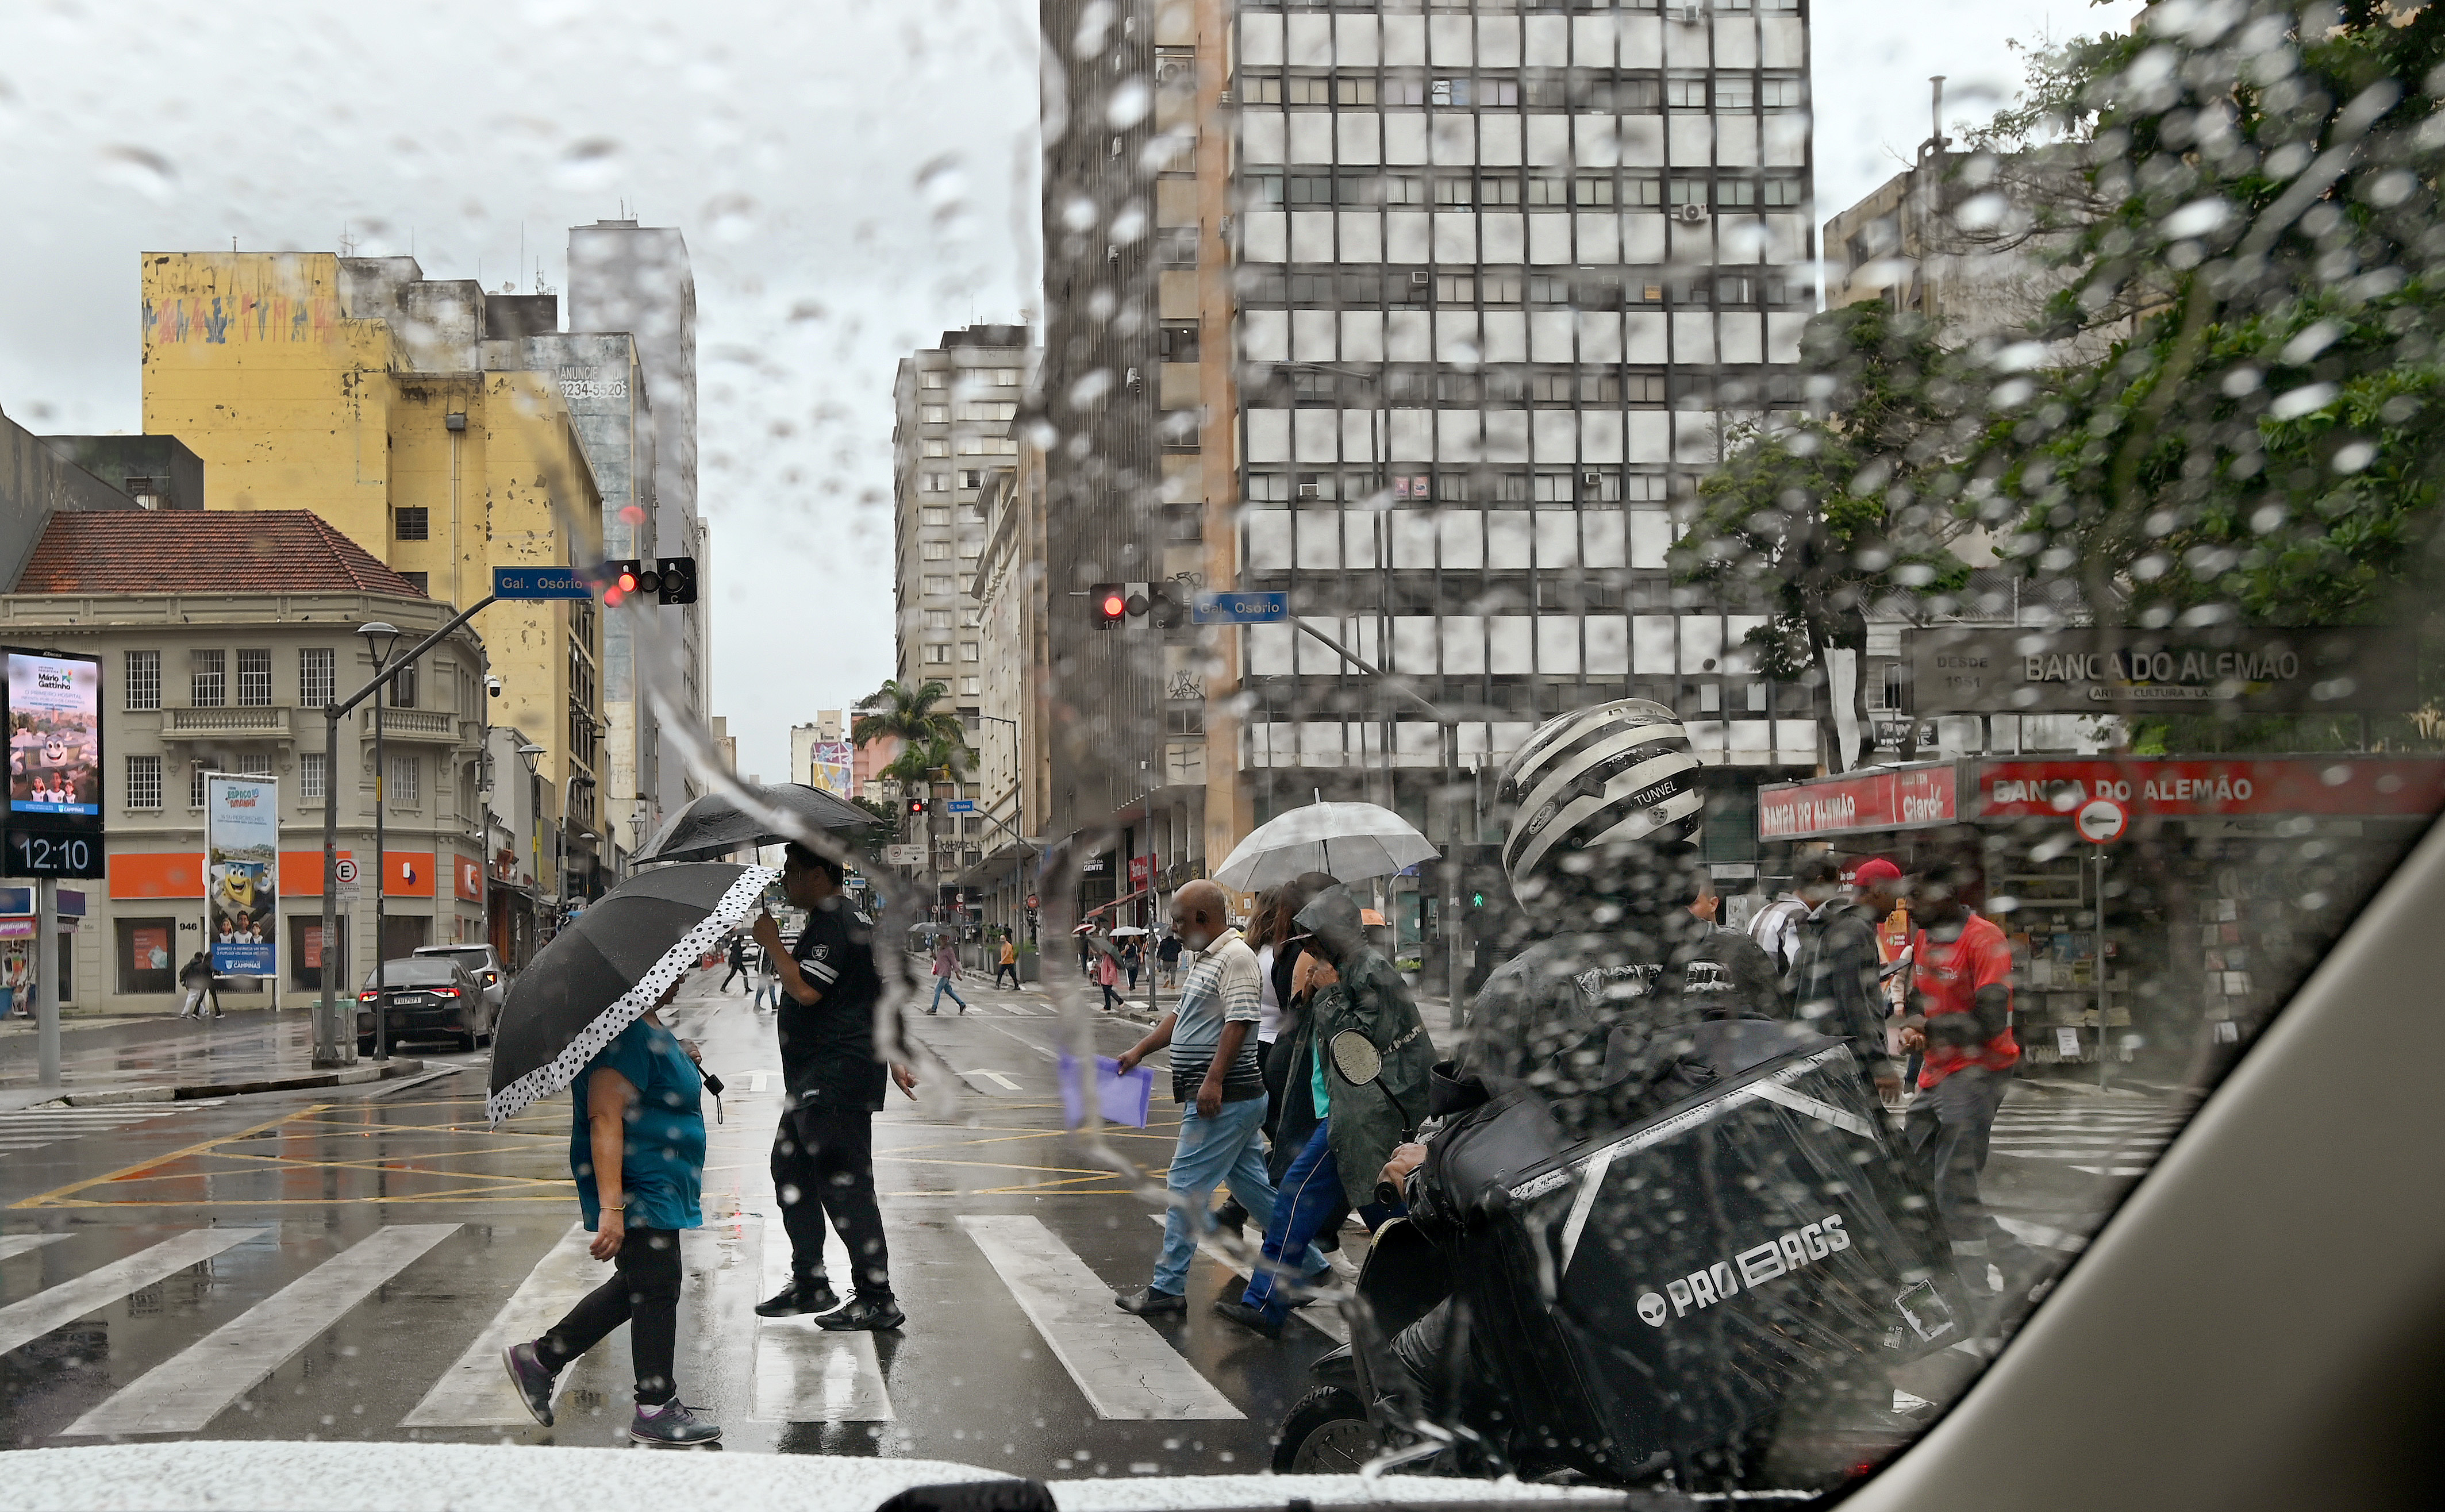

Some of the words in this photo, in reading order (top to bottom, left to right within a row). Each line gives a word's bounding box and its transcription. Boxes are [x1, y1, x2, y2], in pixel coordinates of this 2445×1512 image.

[560, 367, 598, 380] ANUNCIE
[561, 383, 622, 397] 3234-5520
[502, 578, 529, 589] Gal.
[537, 577, 583, 589] Osório
[1200, 603, 1226, 614] Gal.
[1235, 602, 1280, 614] Osório
[1937, 656, 1988, 668] DESDE
[2025, 654, 2126, 681] BANCA
[2131, 652, 2173, 681] DO
[39, 673, 59, 682] Mário
[39, 681, 71, 690] Gattinho
[1633, 780, 1677, 806] TUNNEL
[2096, 779, 2131, 801] DO
[2143, 775, 2252, 801] ALEMÃO
[1904, 786, 1942, 821] Claro
[1763, 803, 1796, 834] BANCA
[1798, 802, 1811, 832] DO
[20, 838, 89, 870] 12:10
[341, 865, 350, 878] E
[1083, 864, 1104, 872] GENTE
[179, 923, 197, 931] 946
[1666, 1261, 1739, 1318] PRO
[1735, 1214, 1851, 1289] BAGS
